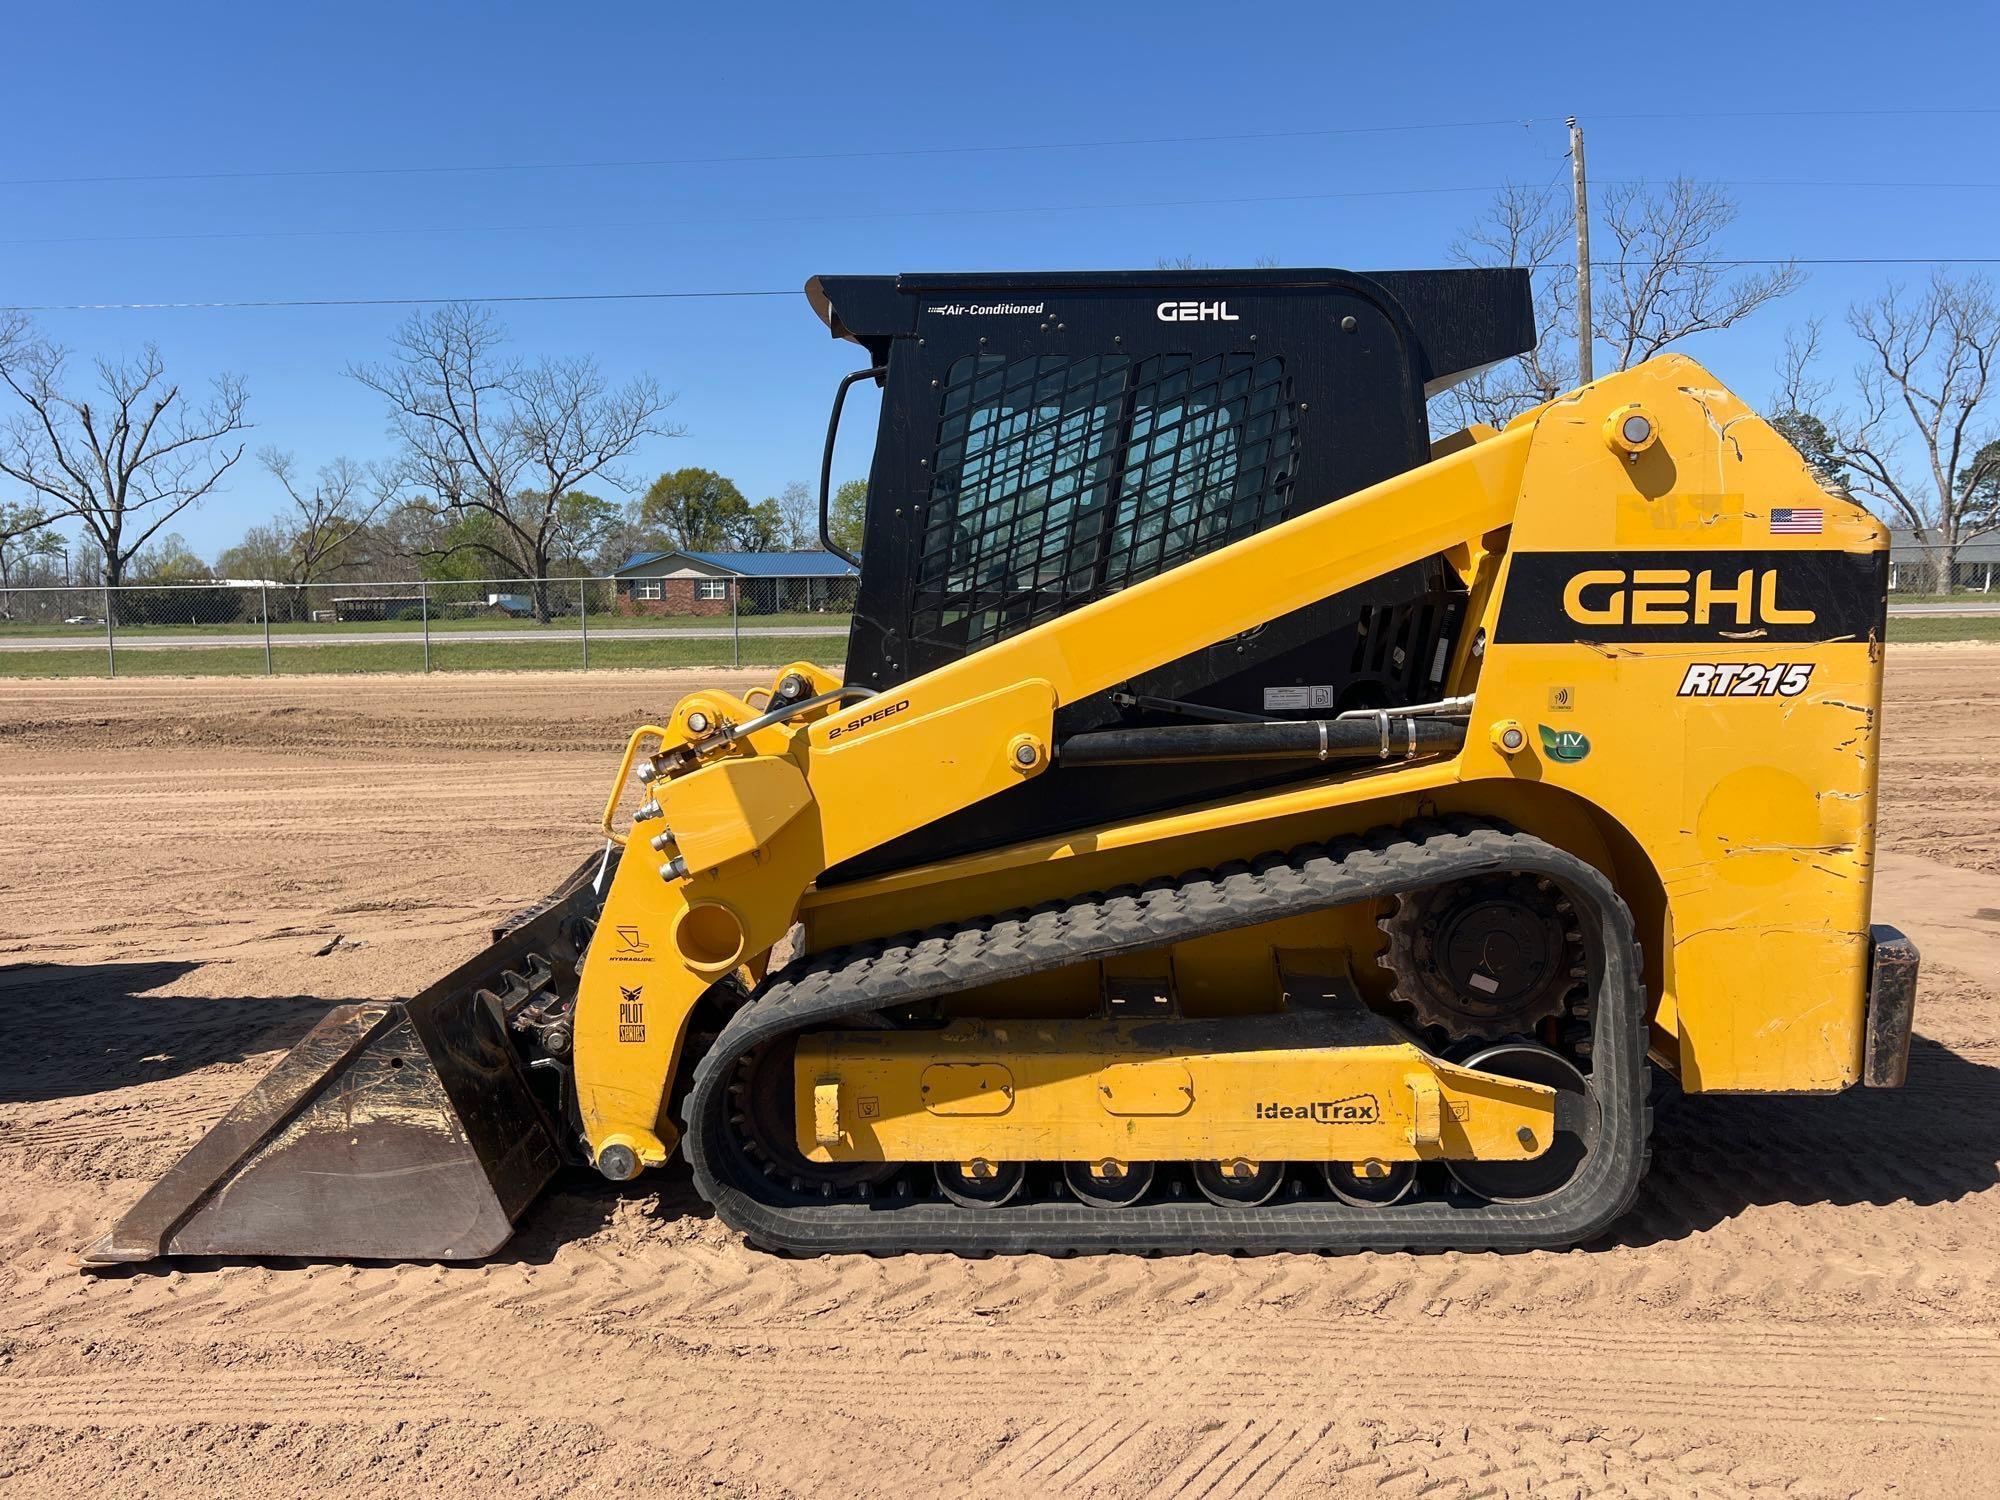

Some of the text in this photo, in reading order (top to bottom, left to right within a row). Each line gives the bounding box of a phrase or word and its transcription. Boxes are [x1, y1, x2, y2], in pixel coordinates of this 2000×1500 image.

[946, 302, 1044, 316] Air-Conditioned
[1157, 301, 1239, 321] GEHL
[1563, 569, 1816, 625] GEHL
[1676, 663, 1816, 696] RT215
[829, 700, 909, 739] 2-SPEED
[619, 1003, 644, 1023] PILOT
[1256, 1102, 1373, 1119] IdealTrax
